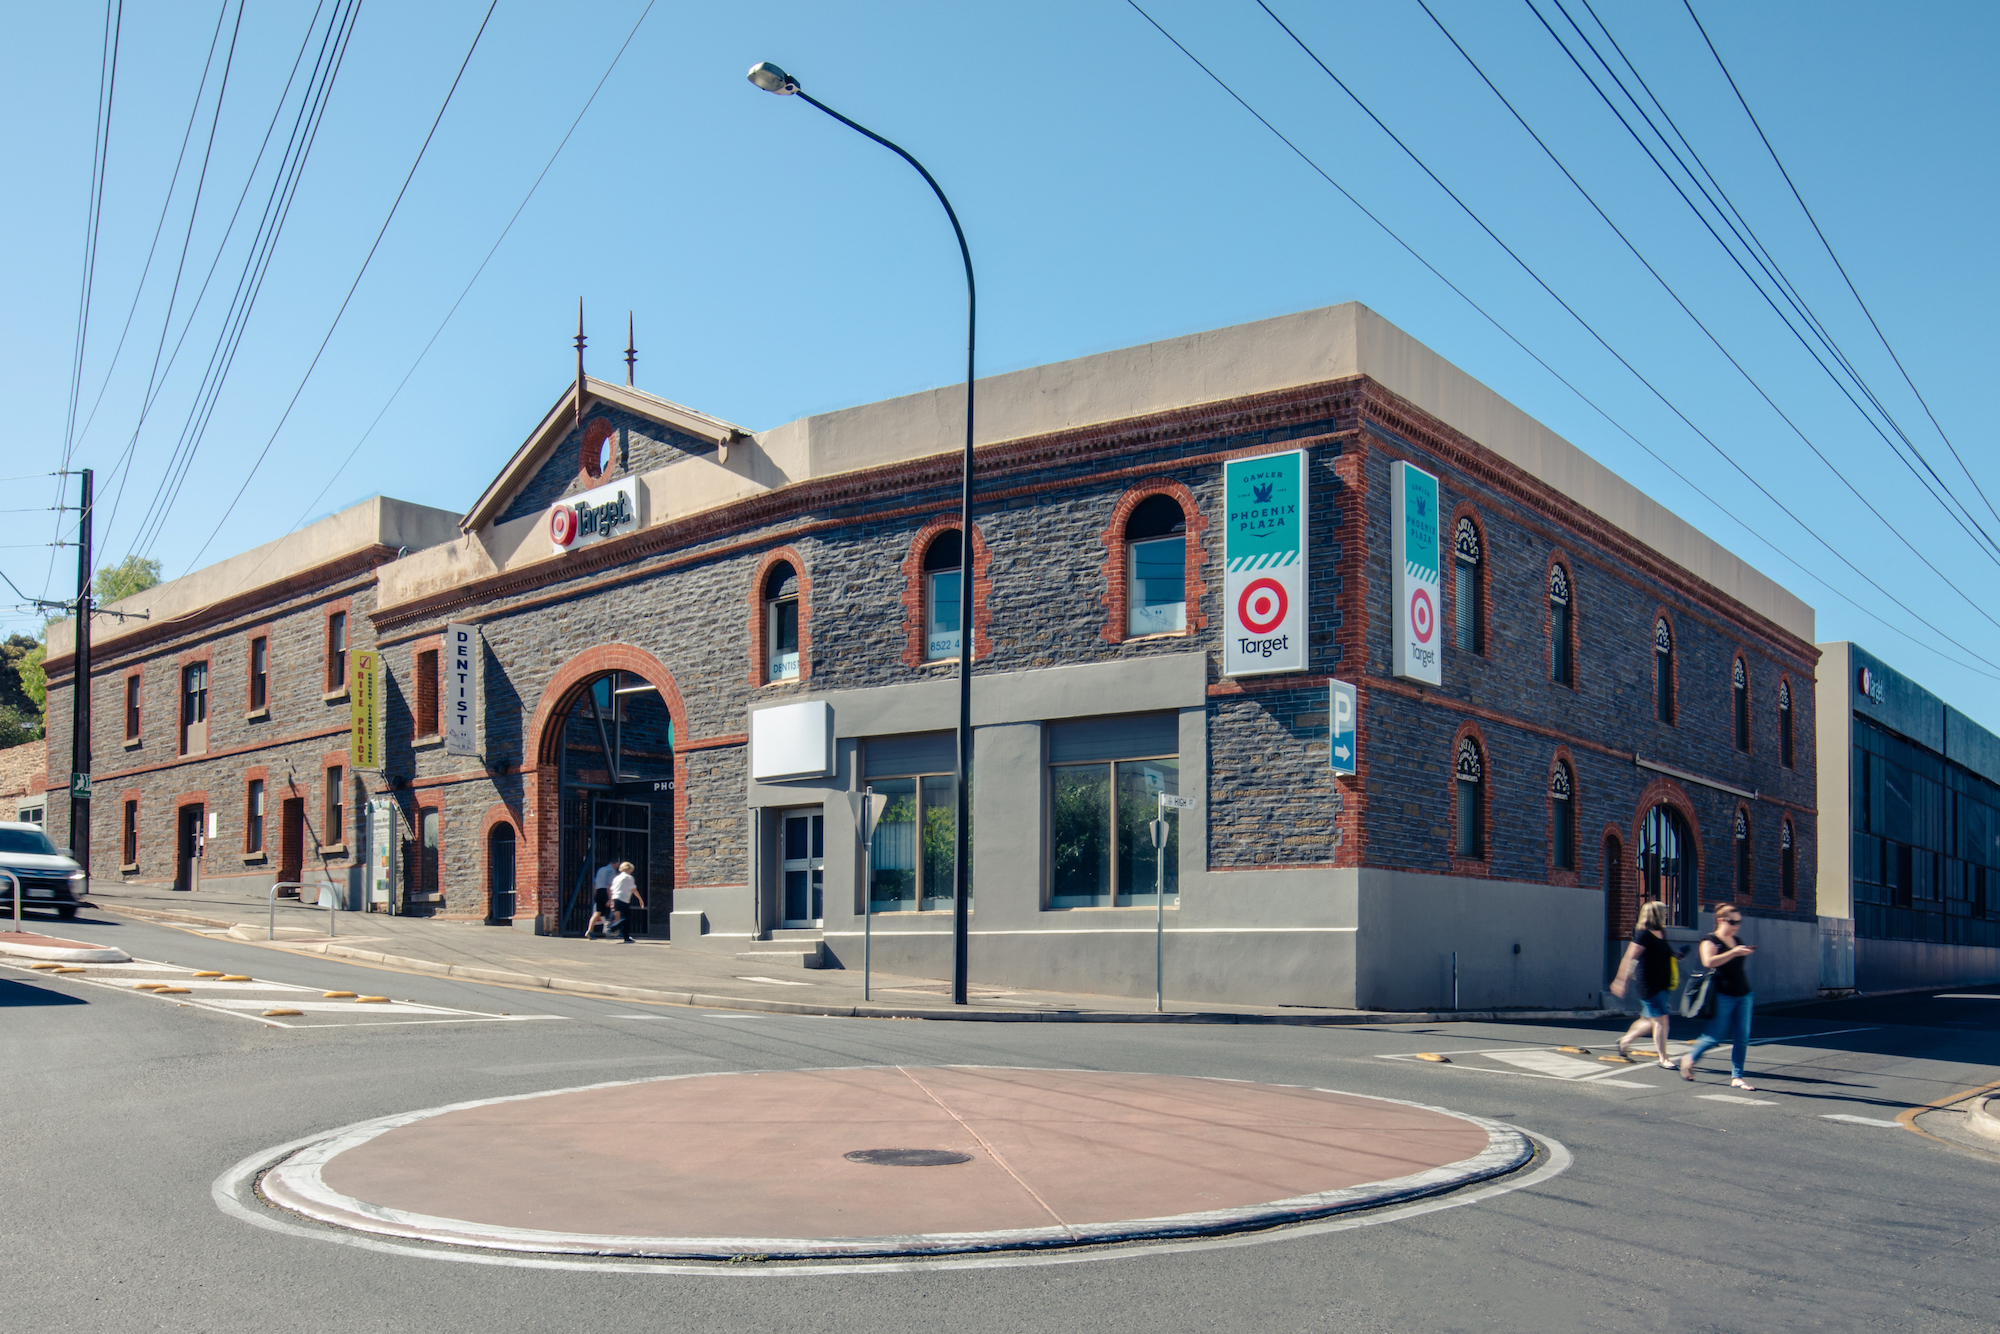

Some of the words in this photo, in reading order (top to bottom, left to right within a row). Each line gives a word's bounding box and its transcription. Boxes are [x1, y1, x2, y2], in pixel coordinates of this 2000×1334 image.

[1243, 471, 1283, 483] GAWLER
[1411, 484, 1431, 498] GAWLER
[1231, 504, 1295, 521] PHOENIX
[1240, 517, 1285, 532] PLAZA
[1407, 515, 1436, 536] PHOENIX
[1411, 528, 1432, 545] PLAZA
[930, 640, 951, 651] 8522
[1238, 634, 1289, 658] Target
[1411, 642, 1435, 668] Target
[457, 631, 468, 725] DENTIST
[1335, 691, 1351, 738] P
[1174, 797, 1187, 807] HIGH
